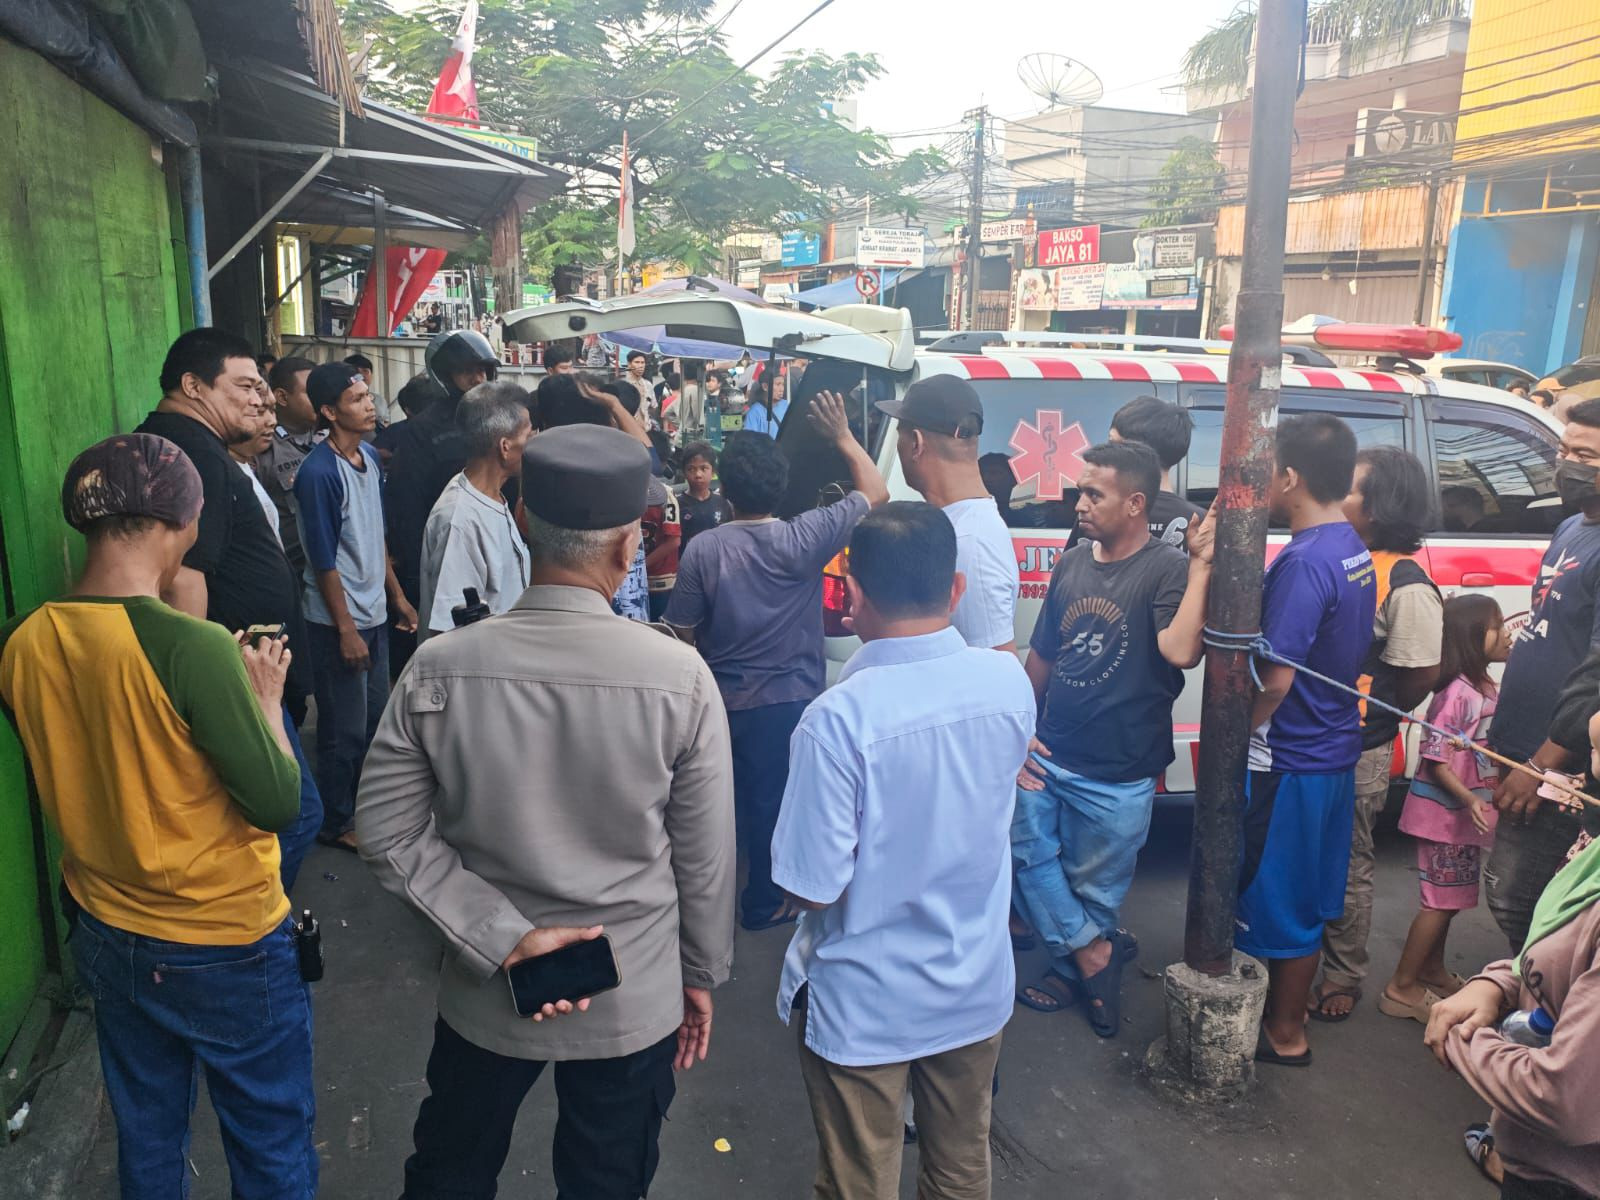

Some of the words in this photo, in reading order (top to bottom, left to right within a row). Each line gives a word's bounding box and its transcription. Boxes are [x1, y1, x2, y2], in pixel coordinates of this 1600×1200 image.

[1052, 228, 1083, 244] BAKSO
[1156, 236, 1180, 244] DOKTER
[1045, 244, 1075, 264] JAYA
[1079, 242, 1092, 262] 81
[1071, 631, 1104, 656] 55
